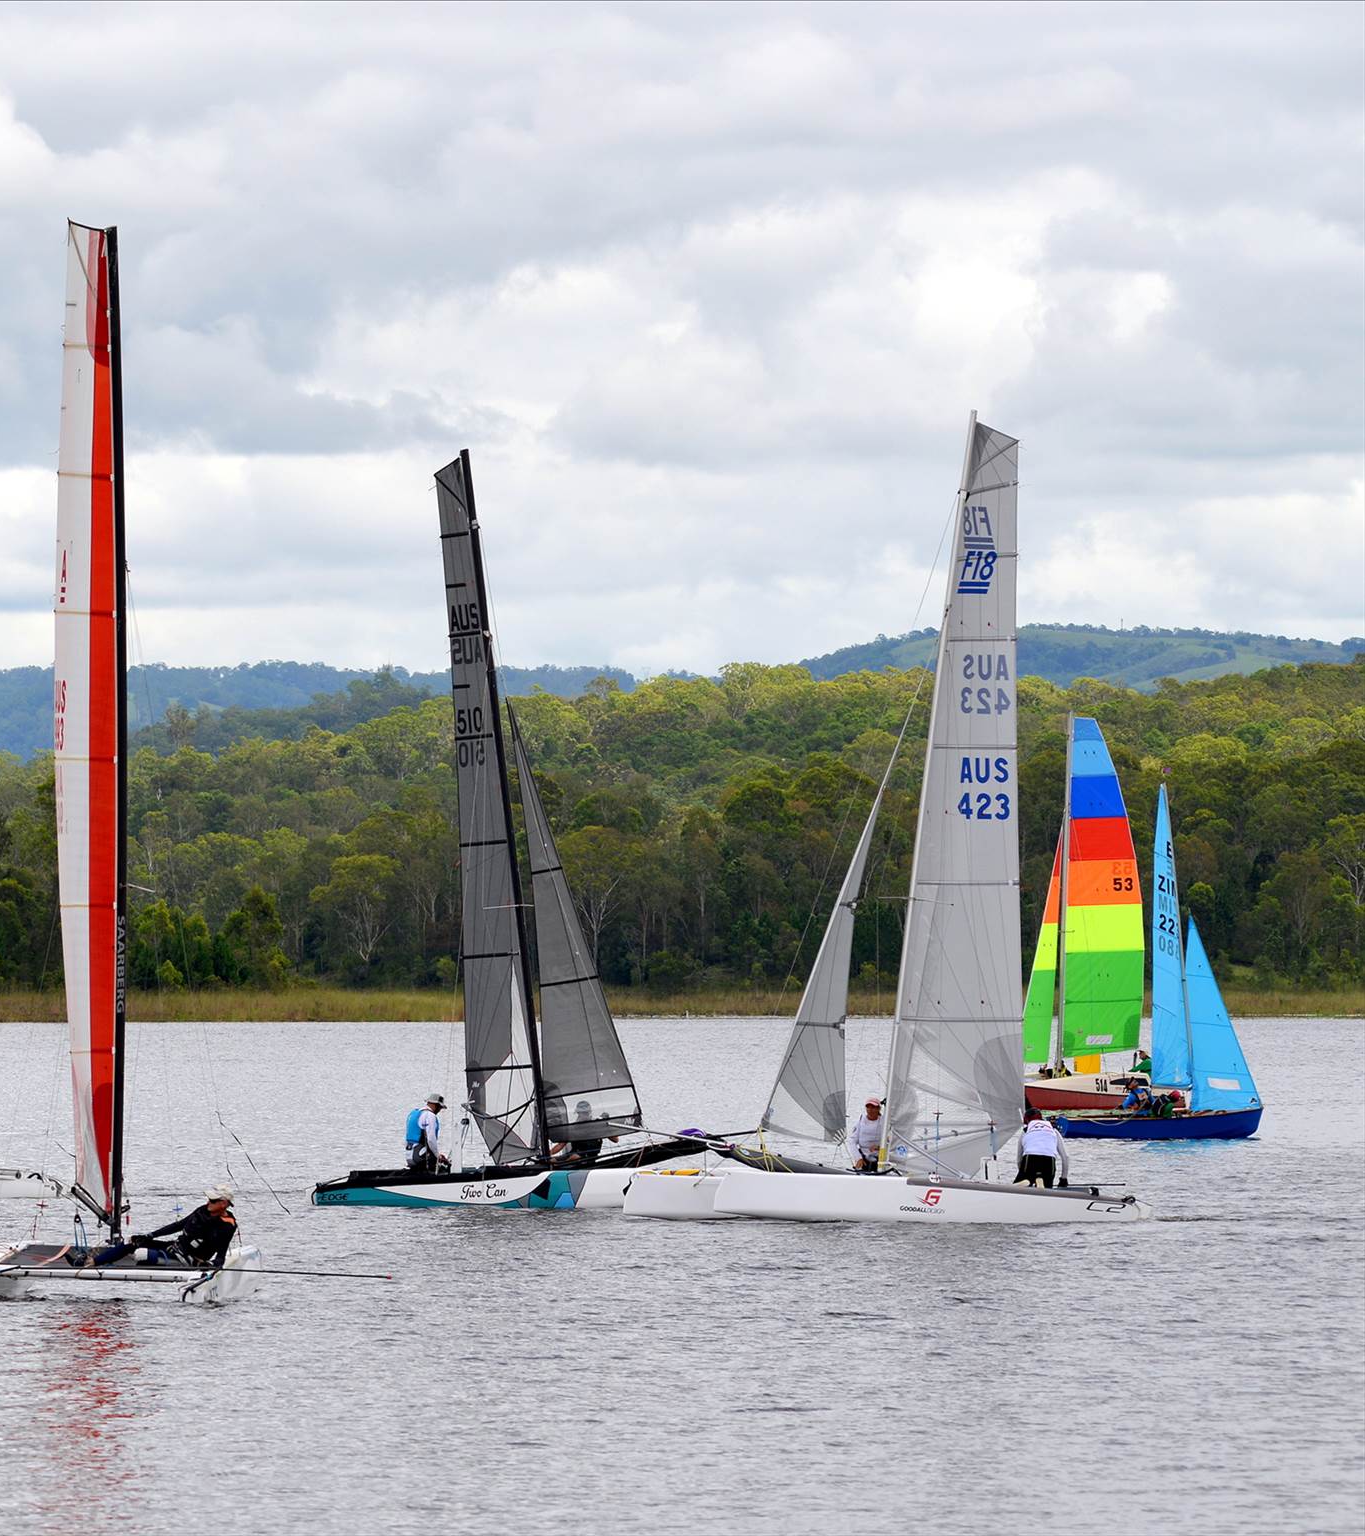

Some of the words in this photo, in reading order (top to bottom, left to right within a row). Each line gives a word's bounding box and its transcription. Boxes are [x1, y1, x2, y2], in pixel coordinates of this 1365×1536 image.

[961, 551, 998, 580] F18
[451, 603, 480, 632] AUS
[457, 706, 482, 735] 510
[960, 757, 1009, 784] AUS
[958, 792, 1010, 820] 423
[1113, 877, 1133, 892] 53
[116, 915, 126, 1014] SAARBERG
[460, 1184, 483, 1200] Two
[485, 1183, 507, 1199] Can
